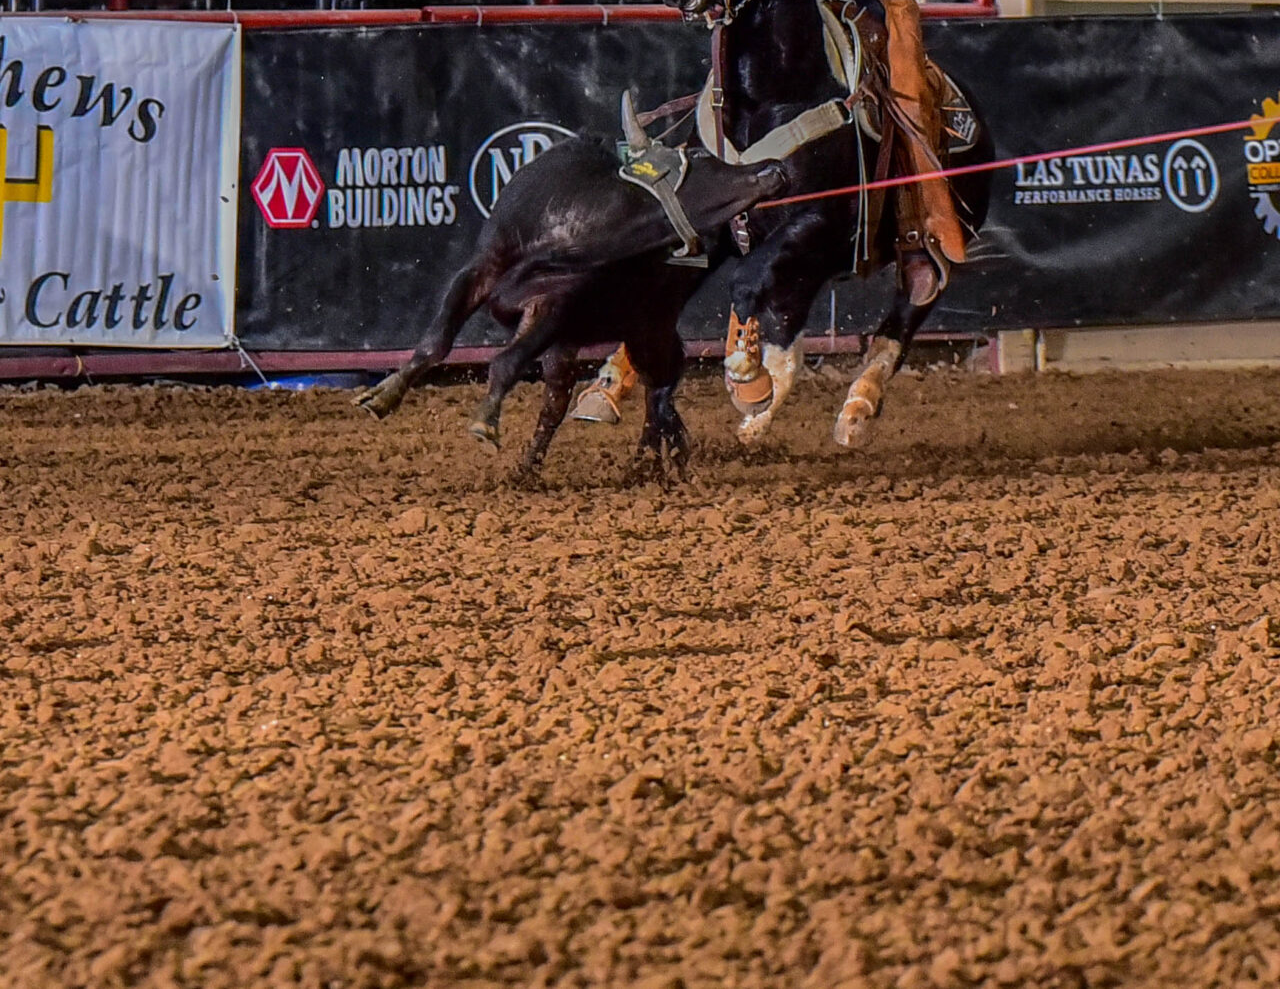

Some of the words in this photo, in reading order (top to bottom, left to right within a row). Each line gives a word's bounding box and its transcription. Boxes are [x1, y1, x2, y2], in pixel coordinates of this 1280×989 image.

[336, 145, 447, 187] MORTON
[1015, 158, 1065, 187] LAS
[1066, 154, 1161, 185] TUNAS
[327, 184, 460, 229] BUILDINGS
[1014, 189, 1112, 205] PERFORMANCE
[1114, 187, 1162, 202] HORSES
[24, 271, 202, 332] Cattle
